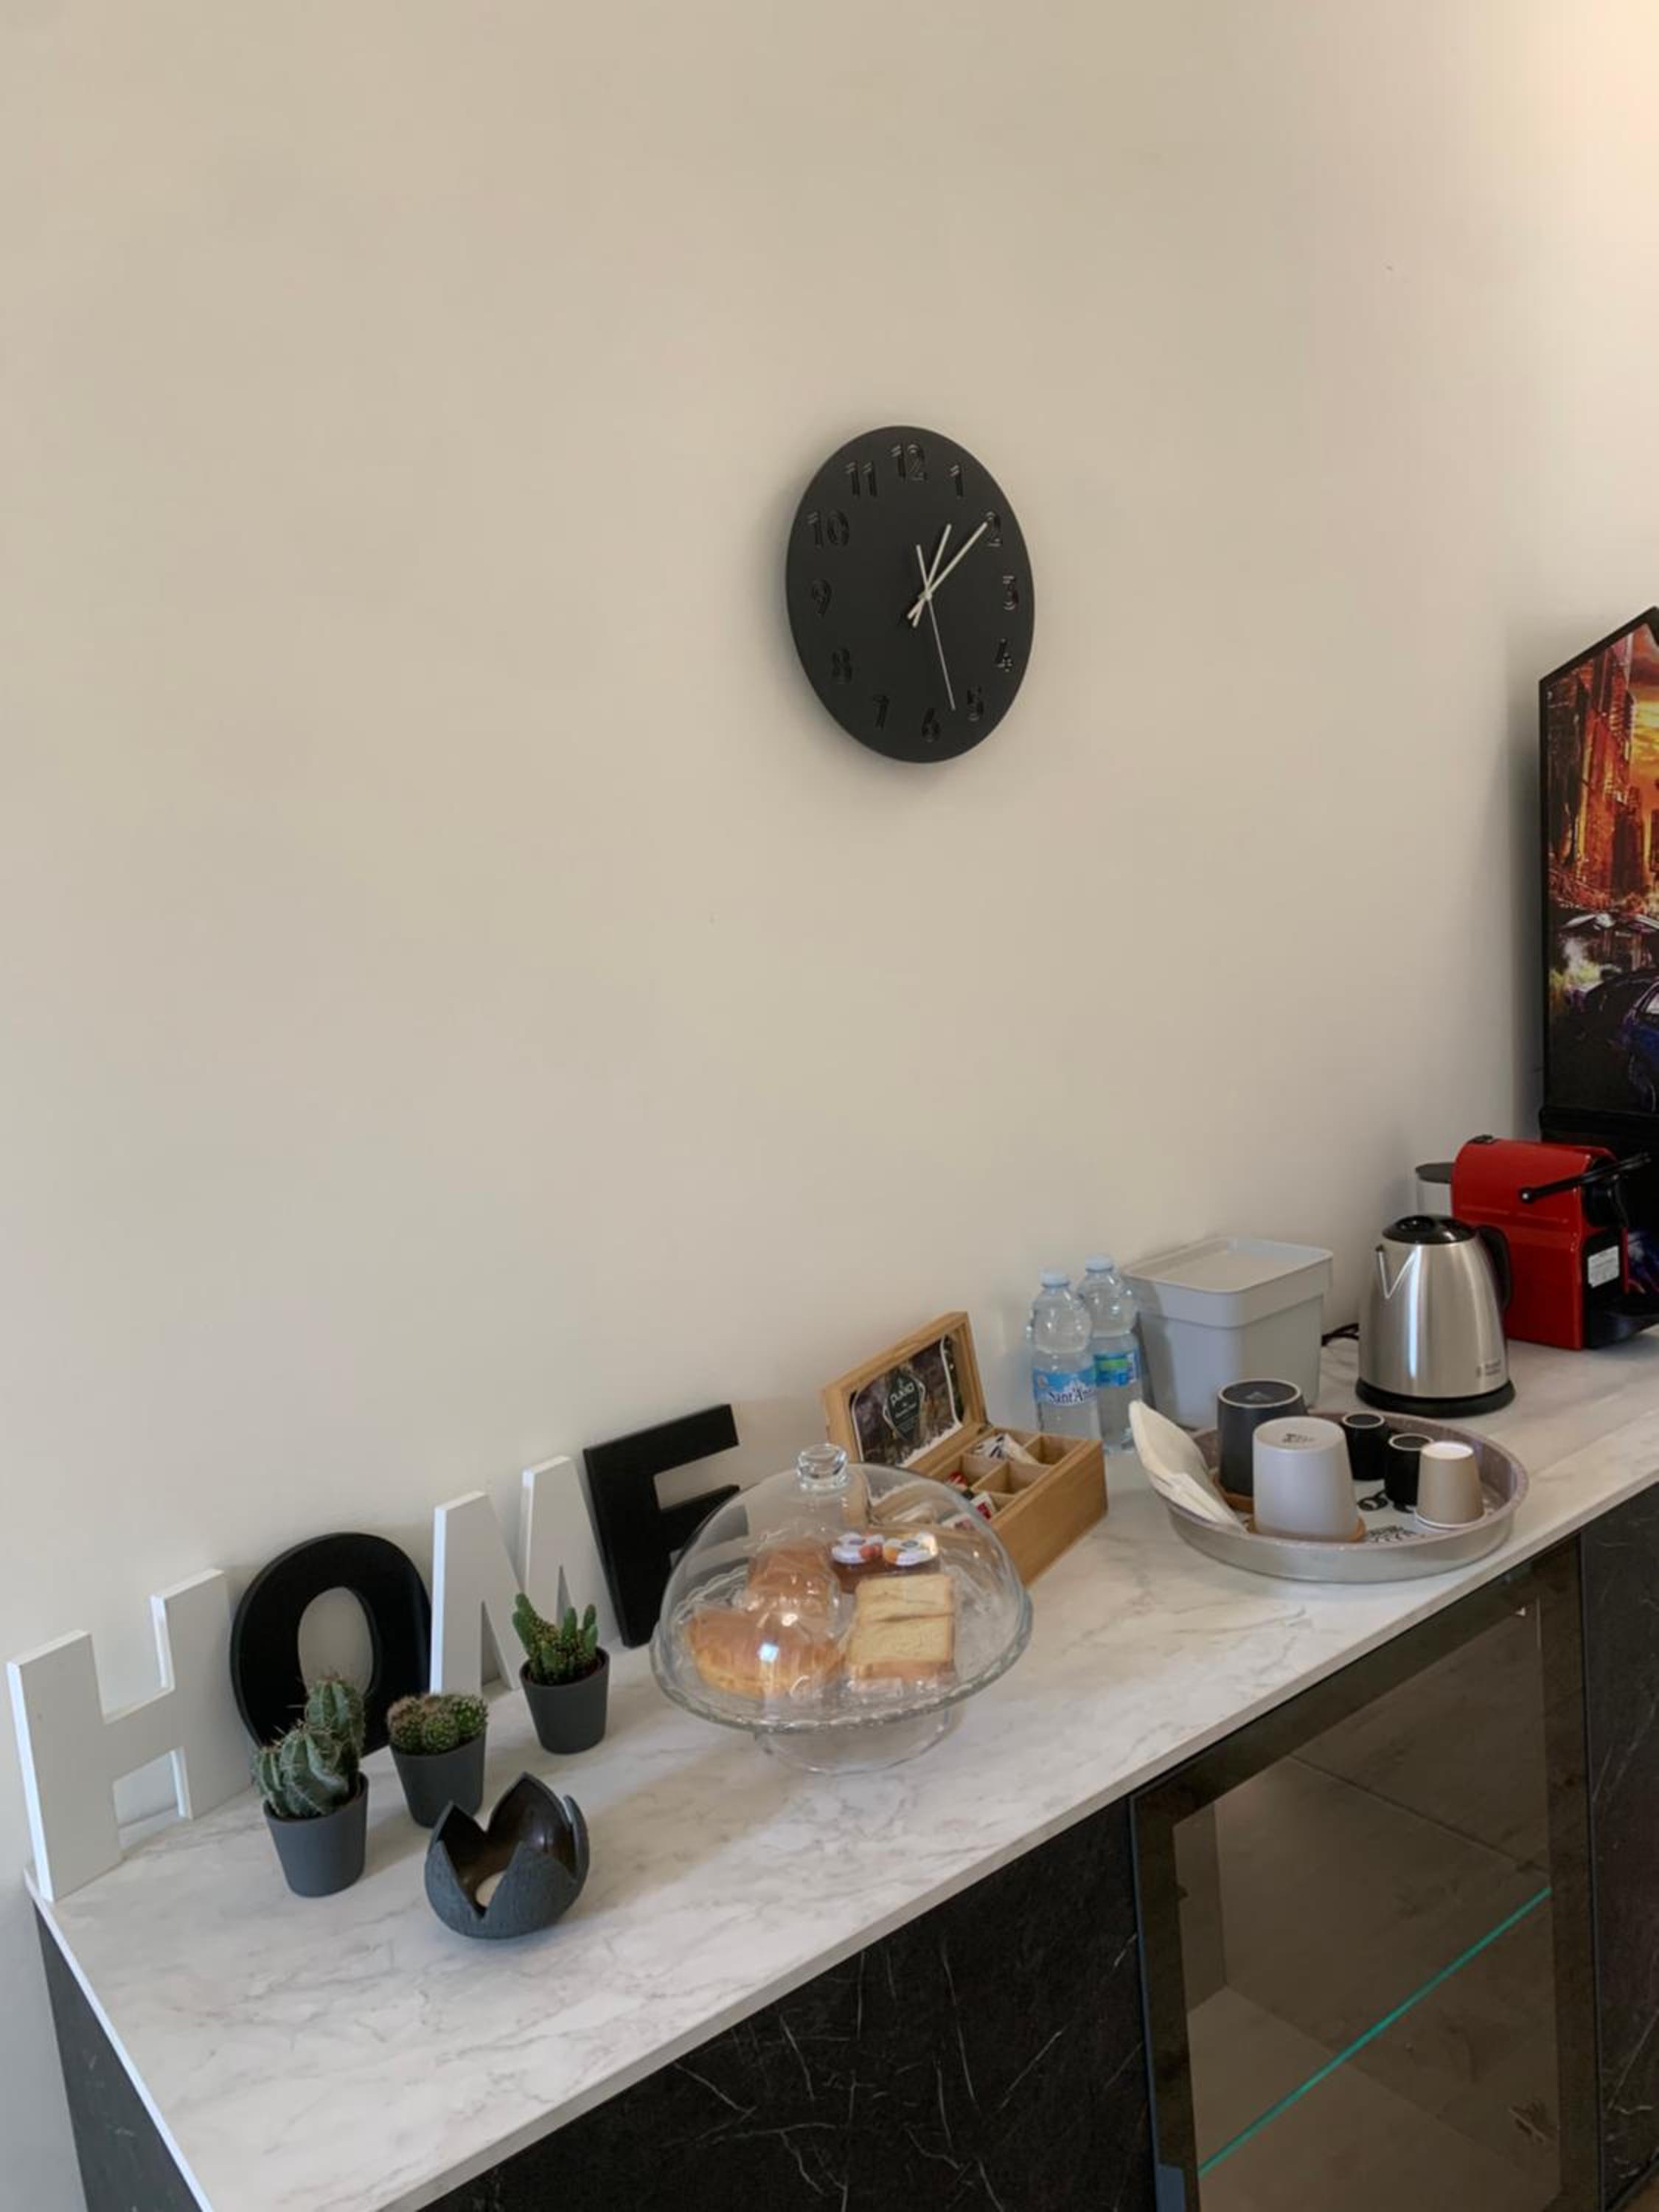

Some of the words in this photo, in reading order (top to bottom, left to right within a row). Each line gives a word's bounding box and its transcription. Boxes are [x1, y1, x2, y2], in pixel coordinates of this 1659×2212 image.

[846, 461, 877, 497] 11
[891, 443, 928, 481] 12
[950, 463, 964, 498] 1
[807, 510, 850, 548] 10
[984, 511, 1004, 547] 2
[812, 579, 832, 615] 9
[1003, 574, 1019, 611] 3
[995, 639, 1013, 672] 4
[872, 694, 889, 729] 7
[967, 686, 985, 721] 5
[921, 708, 941, 742] 6
[7, 1404, 748, 1902] HOME
